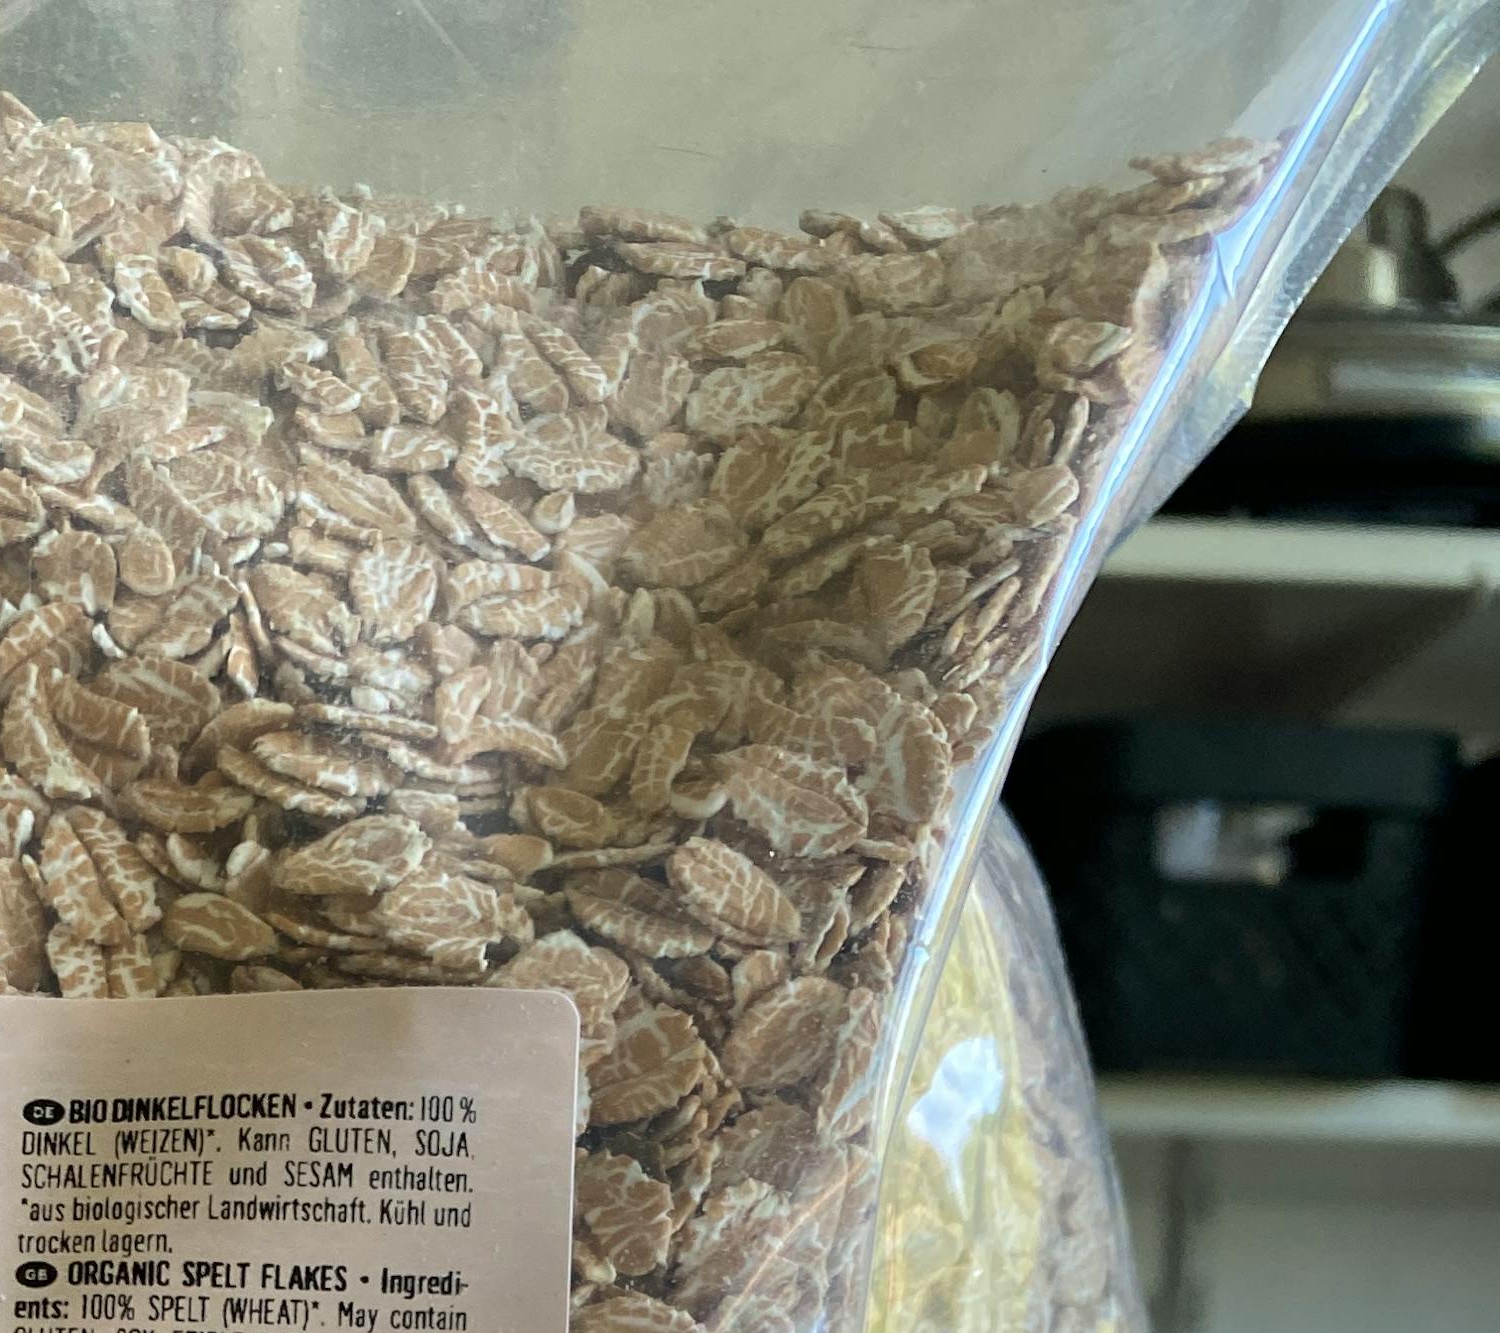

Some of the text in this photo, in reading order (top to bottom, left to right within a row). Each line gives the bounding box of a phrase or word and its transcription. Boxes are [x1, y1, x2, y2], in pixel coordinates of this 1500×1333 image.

[32, 1093, 476, 1124] DE BIO DINKELFLOCKEN Zutaten: 100 %
[22, 1131, 96, 1156] DINKEL
[309, 1126, 396, 1158] GLUTEN,
[21, 1156, 473, 1192] SCHALENFRÜCHTE und SESAM enthalten.
[73, 1194, 200, 1225] biologischer
[208, 1194, 371, 1224] Landwirtschaft.
[380, 1199, 425, 1225] Kühl
[434, 1202, 471, 1228] und
[18, 1229, 172, 1258] trocken lagern.
[24, 1260, 468, 1300] GB ORGANIC SPELT FLAKES Ingredi-
[14, 1297, 69, 1319] ents:
[82, 1294, 135, 1320] 100%
[148, 1294, 210, 1322] SPELT
[338, 1301, 378, 1333] May
[390, 1305, 466, 1331] contain
